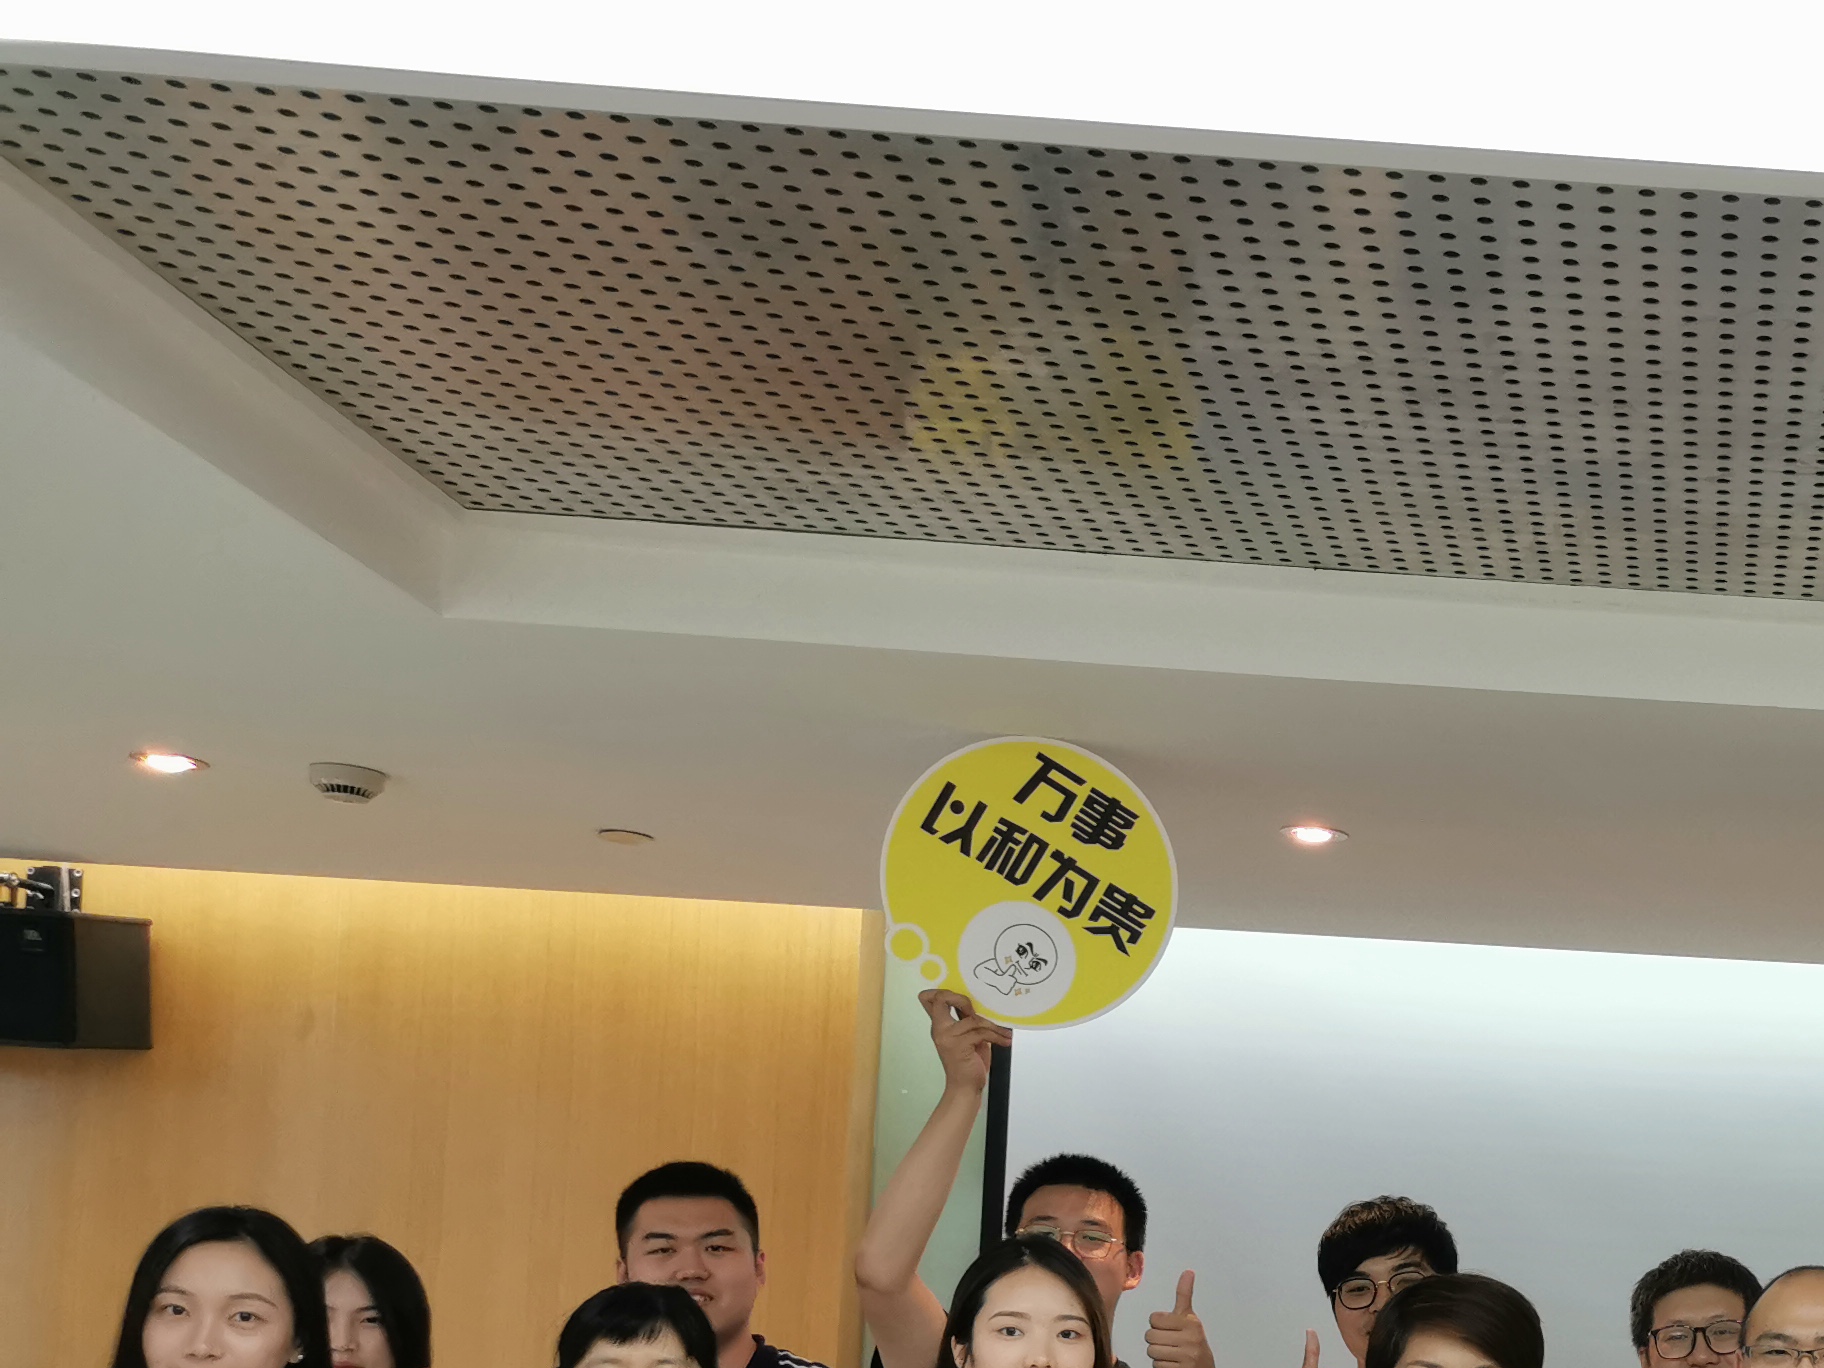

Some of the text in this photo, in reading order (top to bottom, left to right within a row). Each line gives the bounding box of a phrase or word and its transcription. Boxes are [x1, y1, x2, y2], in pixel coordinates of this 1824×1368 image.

[920, 780, 1156, 957] 以和为贵
[1012, 751, 1140, 850] 万事
